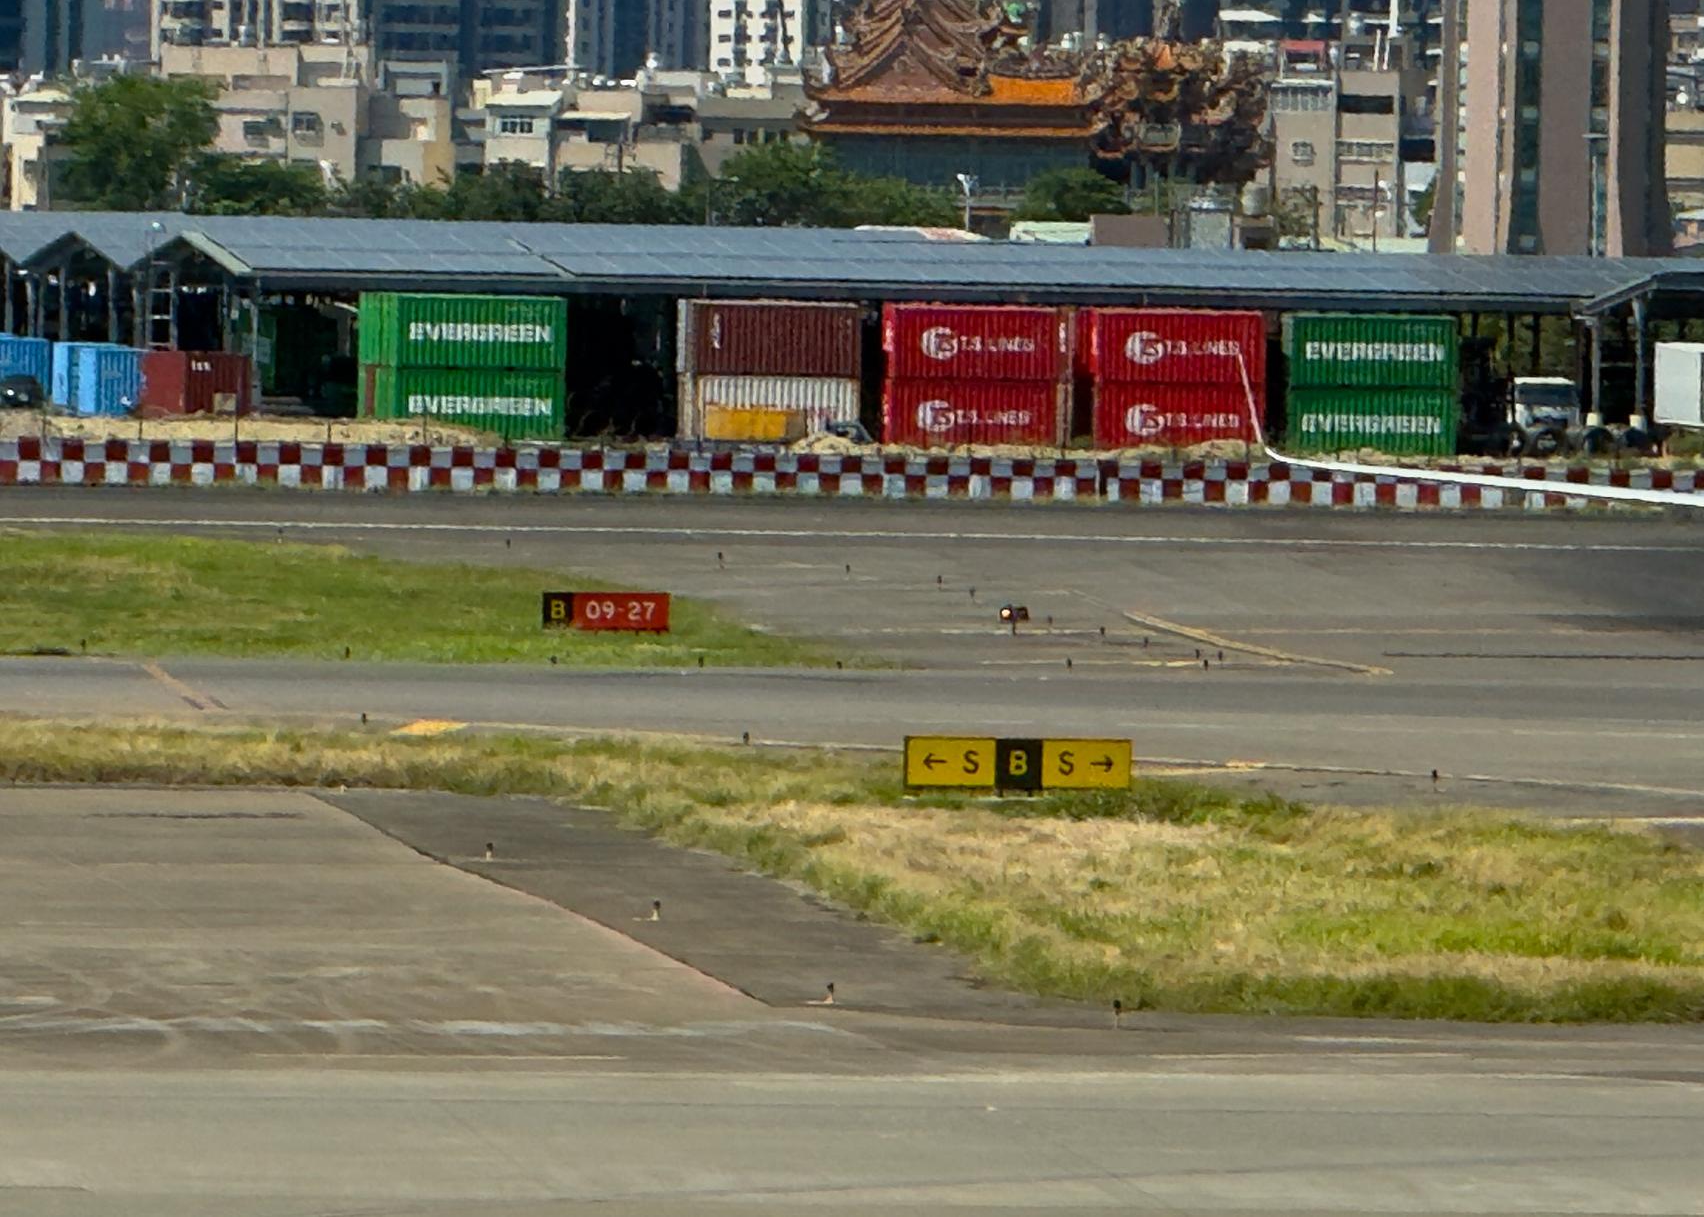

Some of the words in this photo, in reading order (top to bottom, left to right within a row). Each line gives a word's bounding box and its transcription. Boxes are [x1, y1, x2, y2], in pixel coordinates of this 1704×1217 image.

[409, 322, 552, 343] EVERGREEN
[1305, 342, 1445, 362] EVERGREEN
[408, 395, 553, 416] EVERGREEN
[1301, 413, 1441, 434] EVERGREEN
[550, 599, 566, 620] B
[585, 599, 656, 621] 09-27
[962, 750, 980, 775] S
[1009, 749, 1028, 775] B
[1058, 750, 1075, 776] S
